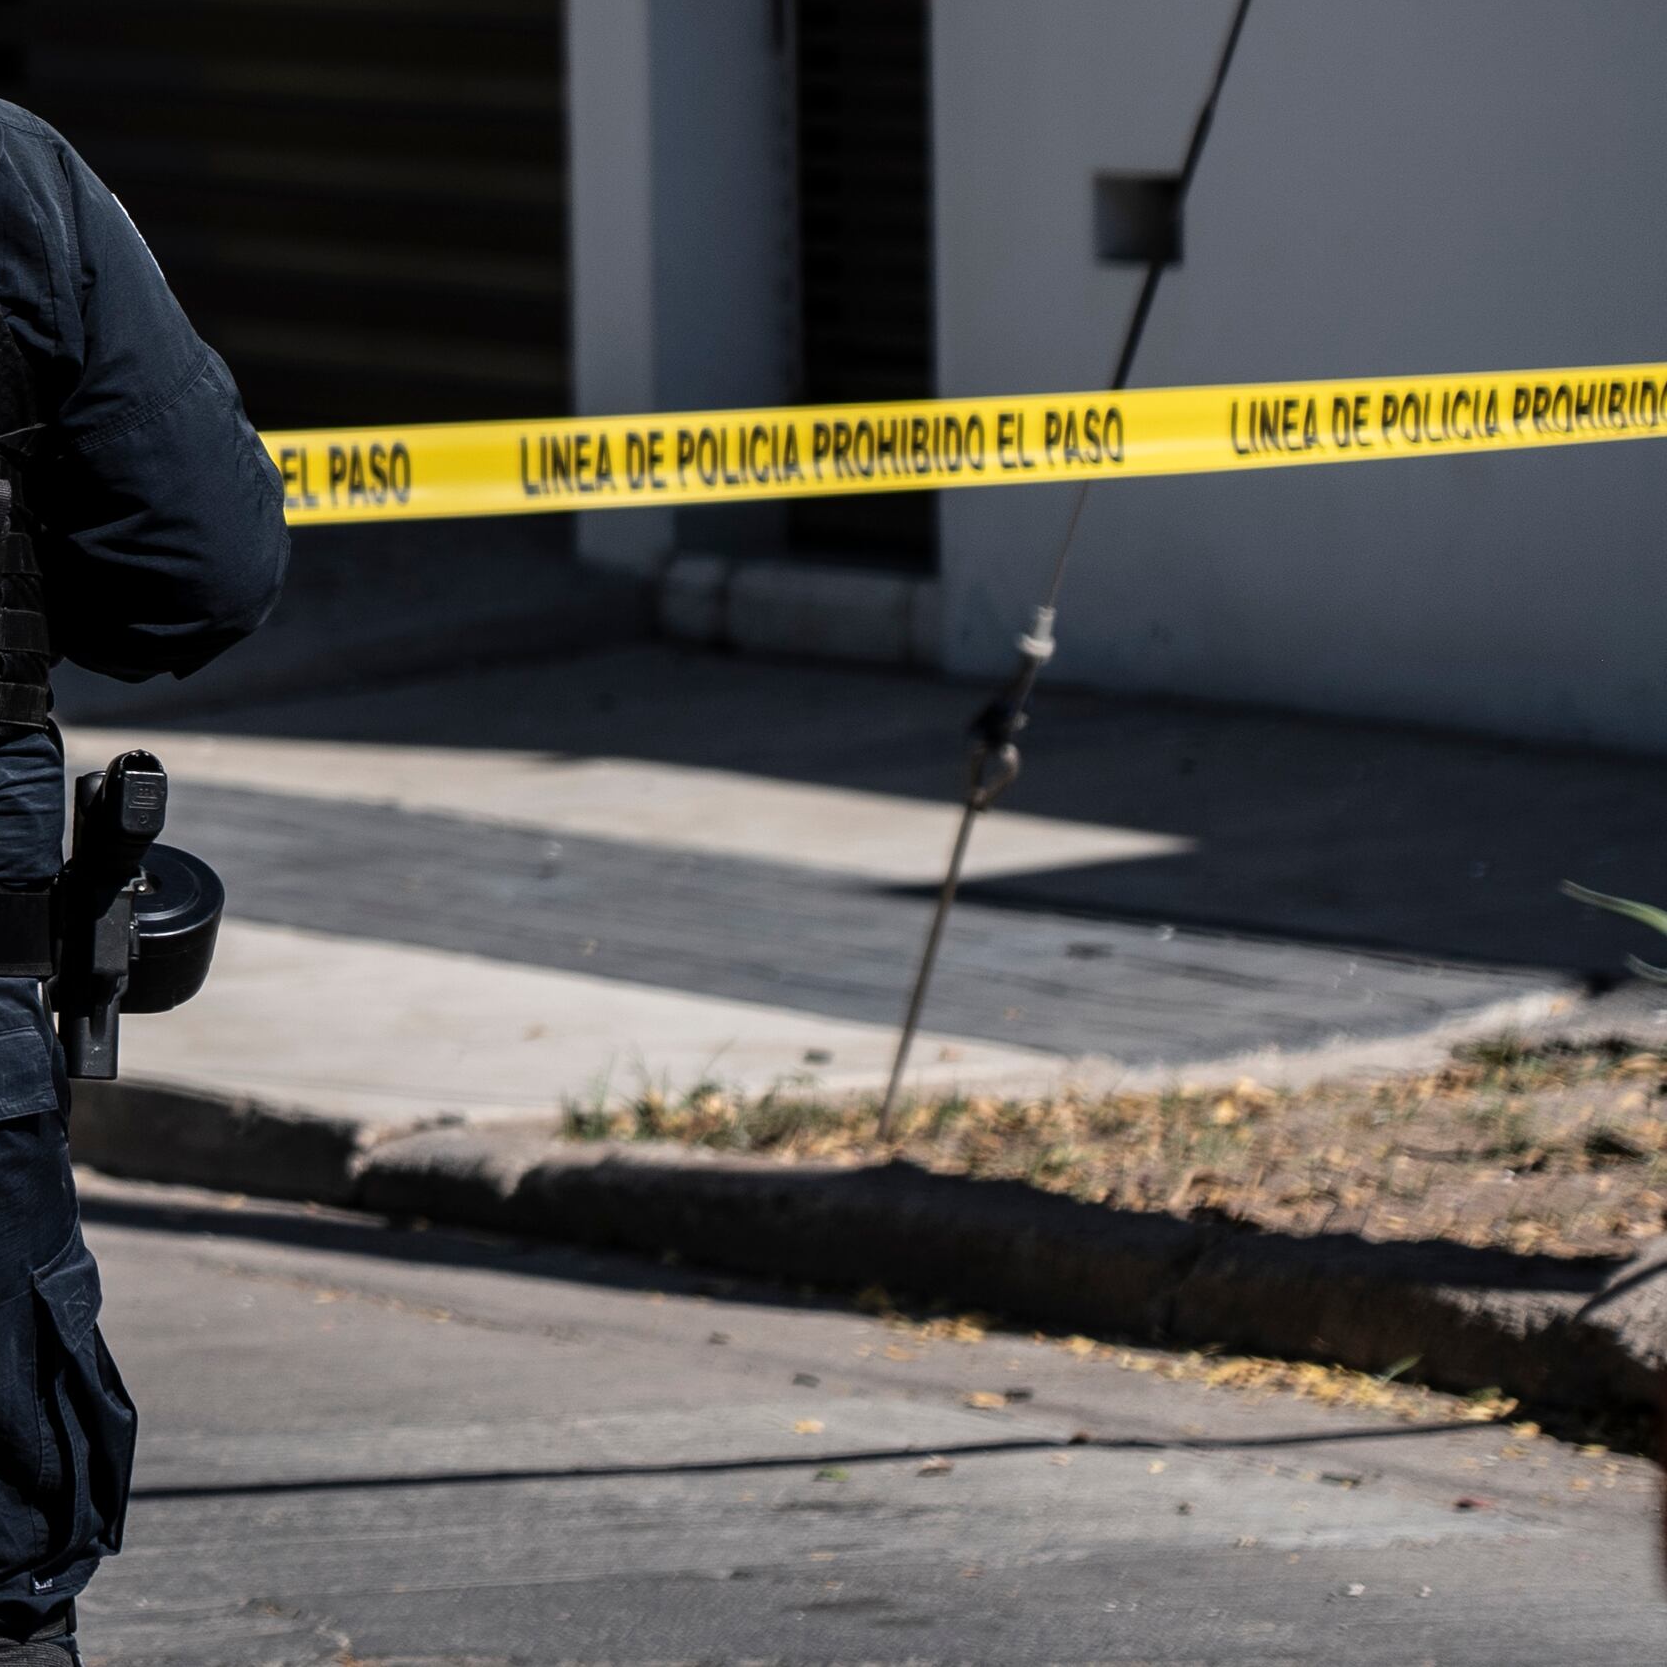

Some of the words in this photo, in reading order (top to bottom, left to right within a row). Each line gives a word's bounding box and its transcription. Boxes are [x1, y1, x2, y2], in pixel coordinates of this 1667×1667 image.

[520, 432, 615, 497] LINEA
[625, 429, 666, 491] DE
[676, 422, 801, 488] POLICIA
[812, 413, 985, 480] PROHIBIDO
[997, 411, 1035, 470] EL
[1044, 405, 1125, 468] PASO
[1230, 397, 1322, 456] LINEA
[1332, 393, 1372, 449] DE
[1382, 386, 1500, 445] POLICIA
[279, 447, 319, 508] EL
[327, 441, 412, 508] PASO
